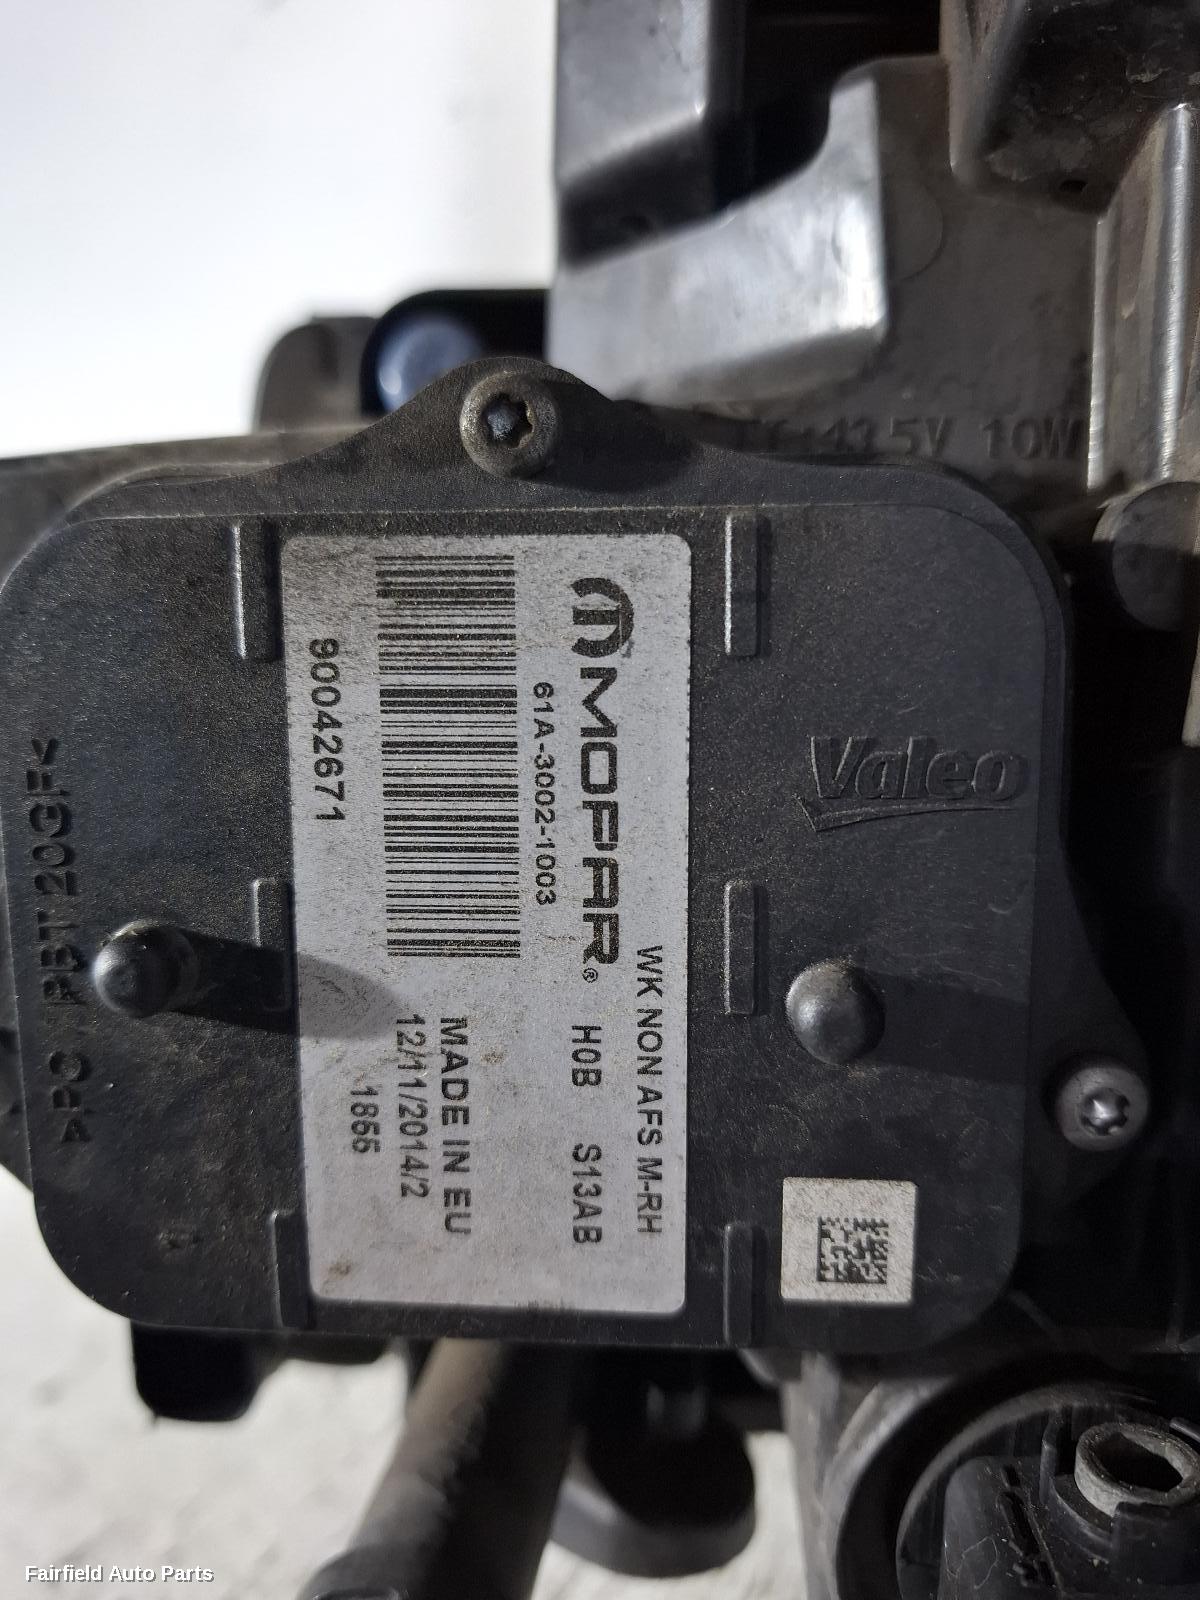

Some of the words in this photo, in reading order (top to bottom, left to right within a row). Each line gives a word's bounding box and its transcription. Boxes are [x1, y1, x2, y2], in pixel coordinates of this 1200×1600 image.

[308, 637, 346, 821] 90042671
[532, 681, 557, 906] 61A-3002-1003
[810, 735, 1030, 801] Valeo
[636, 944, 664, 999] WK
[440, 1017, 470, 1127] MADE
[636, 1008, 664, 1076] NON
[396, 1013, 431, 1199] 12/11/2014/2
[636, 1084, 664, 1146] AFS
[442, 1139, 471, 1173] IN
[443, 1187, 472, 1235] EU
[571, 1142, 604, 1245] S13AB
[636, 1156, 664, 1234] M-RH
